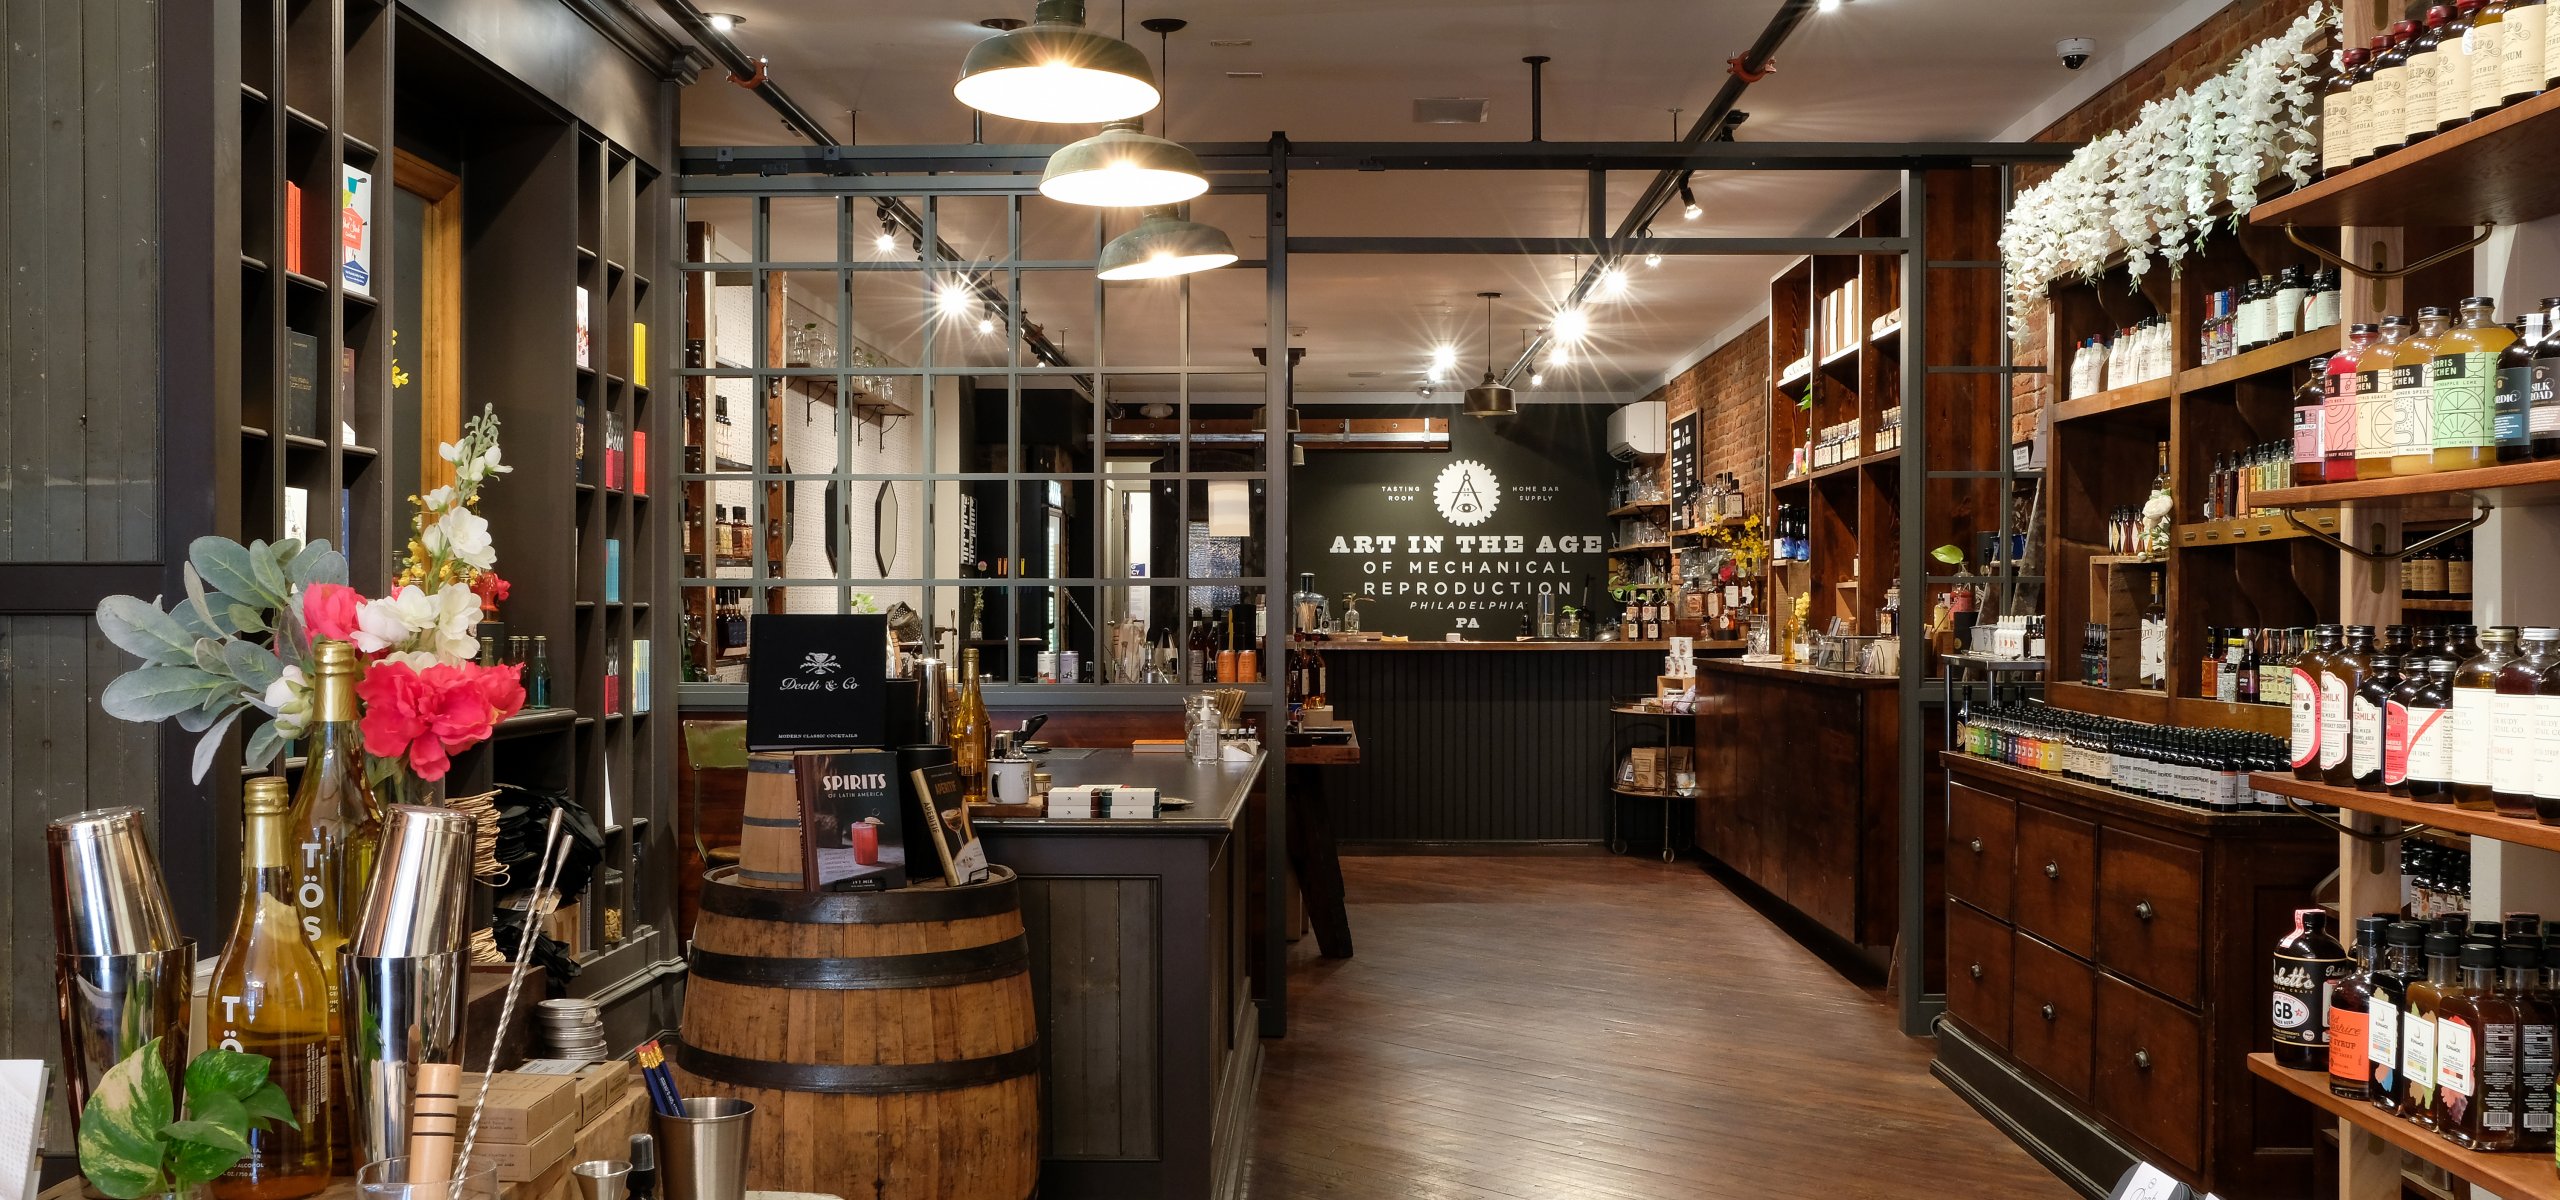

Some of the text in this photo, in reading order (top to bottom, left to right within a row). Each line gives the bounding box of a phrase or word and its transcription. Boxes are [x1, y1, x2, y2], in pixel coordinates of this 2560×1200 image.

[2532, 381, 2551, 392] SILK
[1329, 535, 1603, 554] ART IN THE AGE
[1363, 560, 1571, 575] OF MECHANICAL
[1364, 581, 1571, 596] REPRODUCTION
[1409, 601, 1525, 610] PHILADELPHIA
[1456, 617, 1480, 629] PA
[780, 676, 860, 692] Death & Co
[822, 773, 887, 791] SPIRITS
[298, 843, 324, 957] TÖS
[2274, 1000, 2293, 1020] GB
